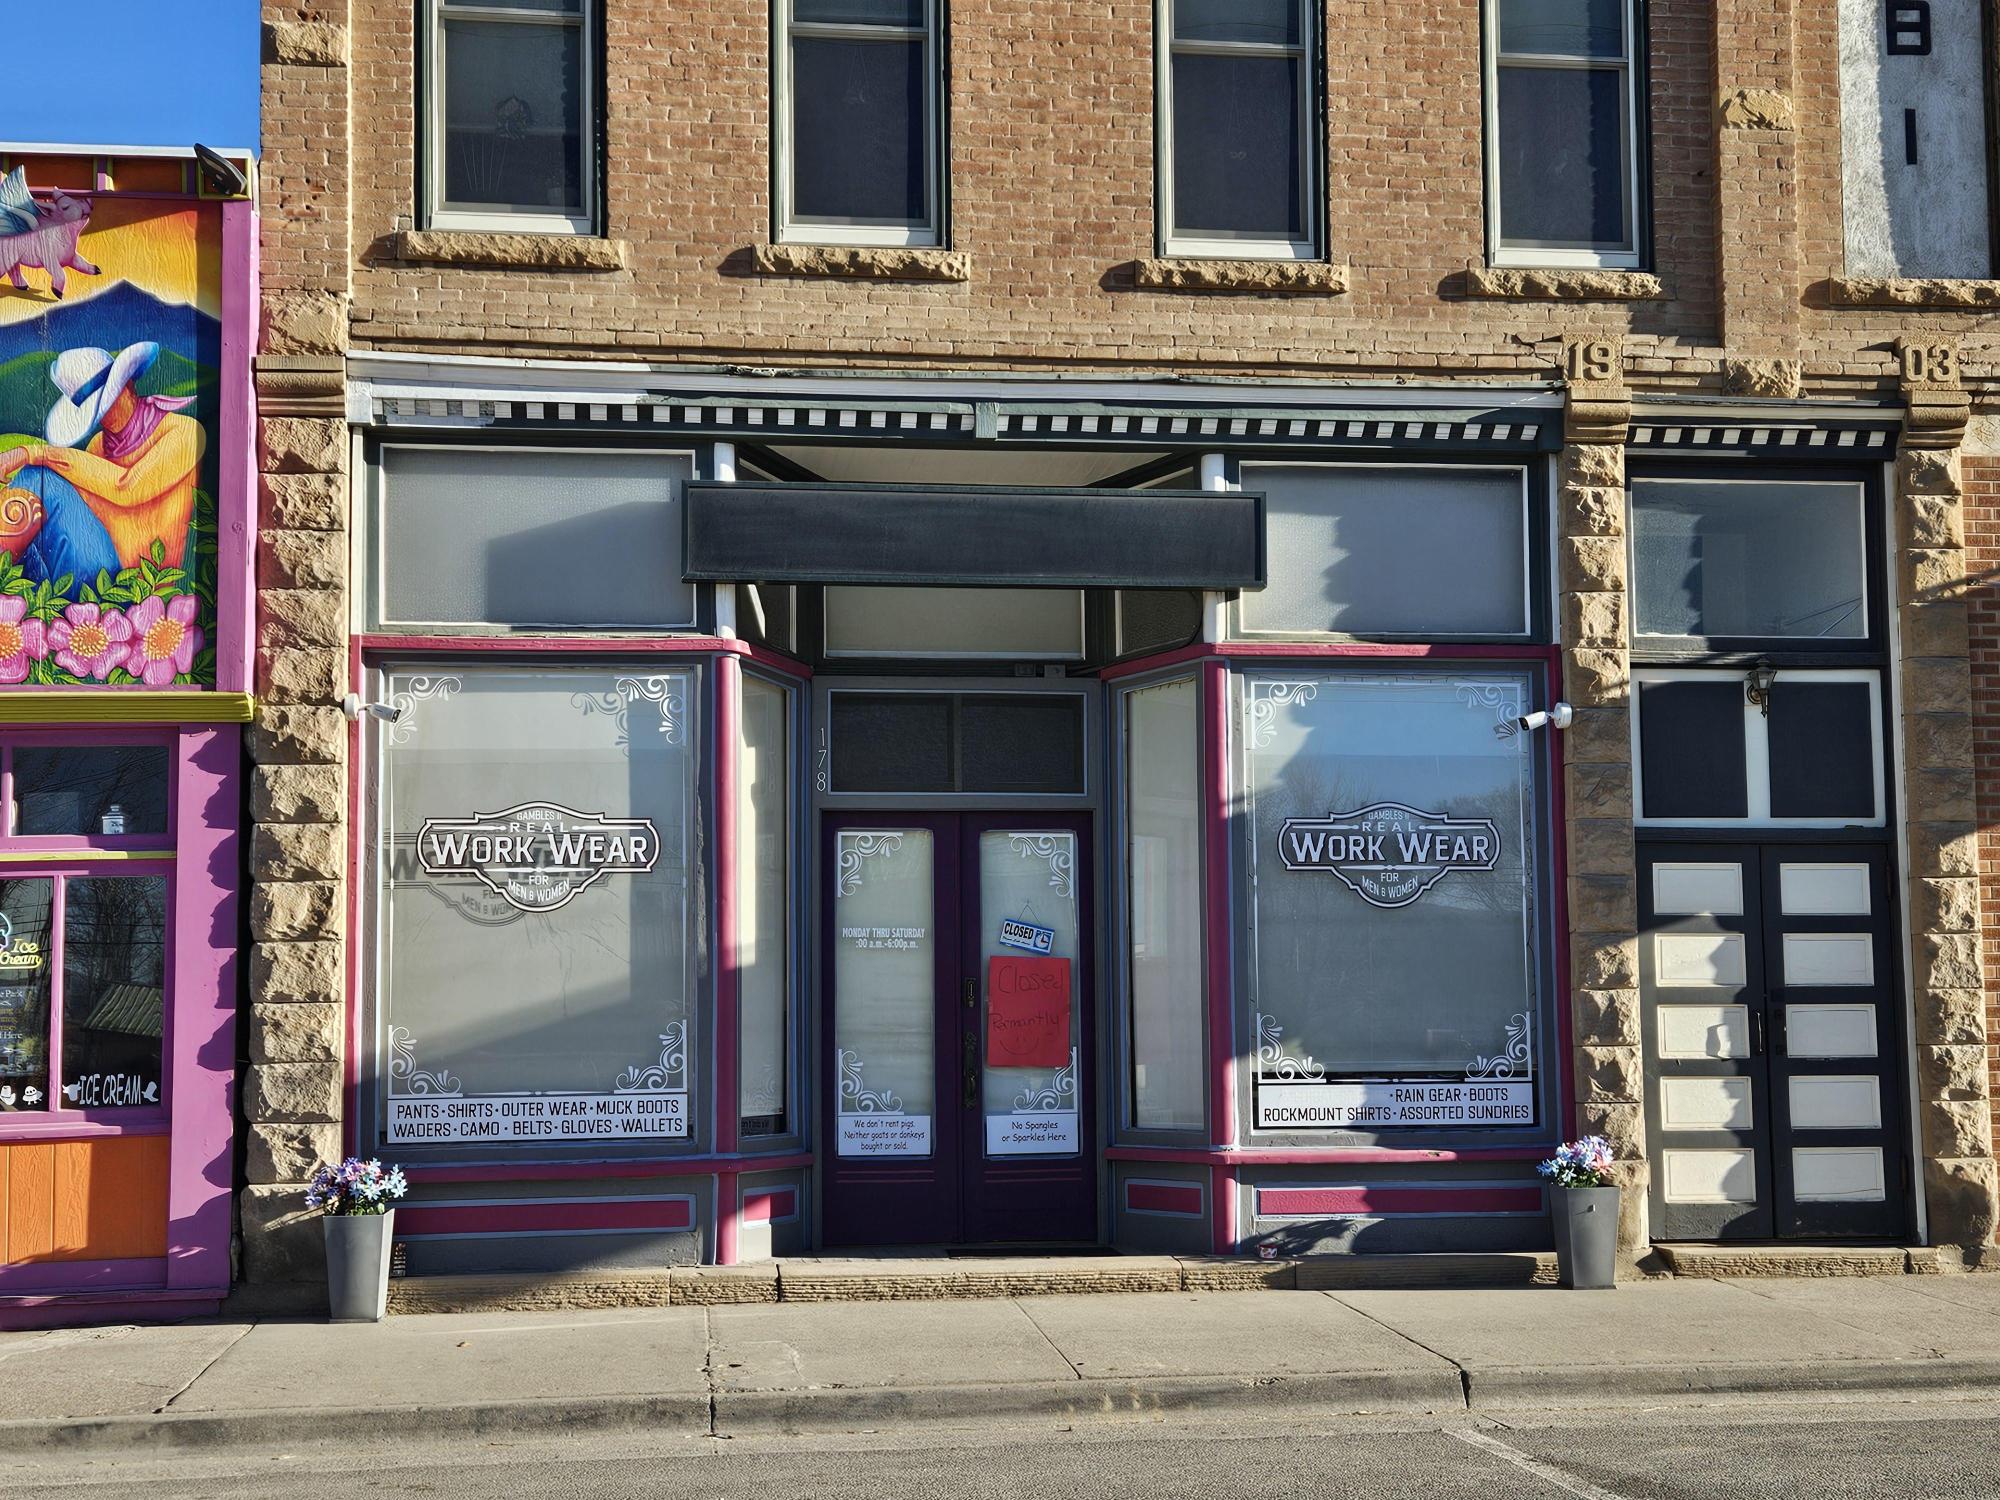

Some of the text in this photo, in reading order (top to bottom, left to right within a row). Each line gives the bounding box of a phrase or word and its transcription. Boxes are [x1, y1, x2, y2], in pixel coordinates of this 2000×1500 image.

[1572, 340, 1616, 381] 19
[1905, 344, 1956, 383] 03
[816, 727, 827, 792] 178
[516, 810, 555, 821] GAMBLES
[509, 822, 569, 833] REAL
[1362, 821, 1417, 832] REAL
[528, 875, 549, 885] FOR
[1380, 872, 1399, 882] FOR
[508, 878, 527, 899] MEN
[536, 877, 570, 902] WOMEN
[1361, 875, 1380, 896] MEN
[1387, 875, 1419, 899] WOMEN
[842, 927, 925, 938] MONDAY THRU SATURDAY
[1004, 922, 1034, 940] CLOSED
[13, 938, 39, 953] Ice
[0, 953, 42, 965] Cream
[79, 1074, 142, 1106] ICE CREAM
[1395, 1087, 1509, 1103] RAIN GEAR BOOTS
[396, 1099, 680, 1119] PANTS SHIRTS OUTER WEAR MUCK BOOTS
[1264, 1104, 1530, 1122] ROCKMOUNT SHIRTS ASSORTED SUNDRIES
[393, 1117, 683, 1138] WADERS CAMO BELTS GLOVES WALLETS
[853, 1119, 865, 1128] We
[885, 1120, 899, 1128] rent
[1011, 1120, 1058, 1132] No Spangles
[844, 1130, 870, 1139] Neither
[870, 1132, 889, 1141] goats
[899, 1130, 925, 1140] donkeys
[1012, 1132, 1046, 1144] Sparkles
[1047, 1132, 1067, 1141] Here
[860, 1142, 883, 1153] bought
